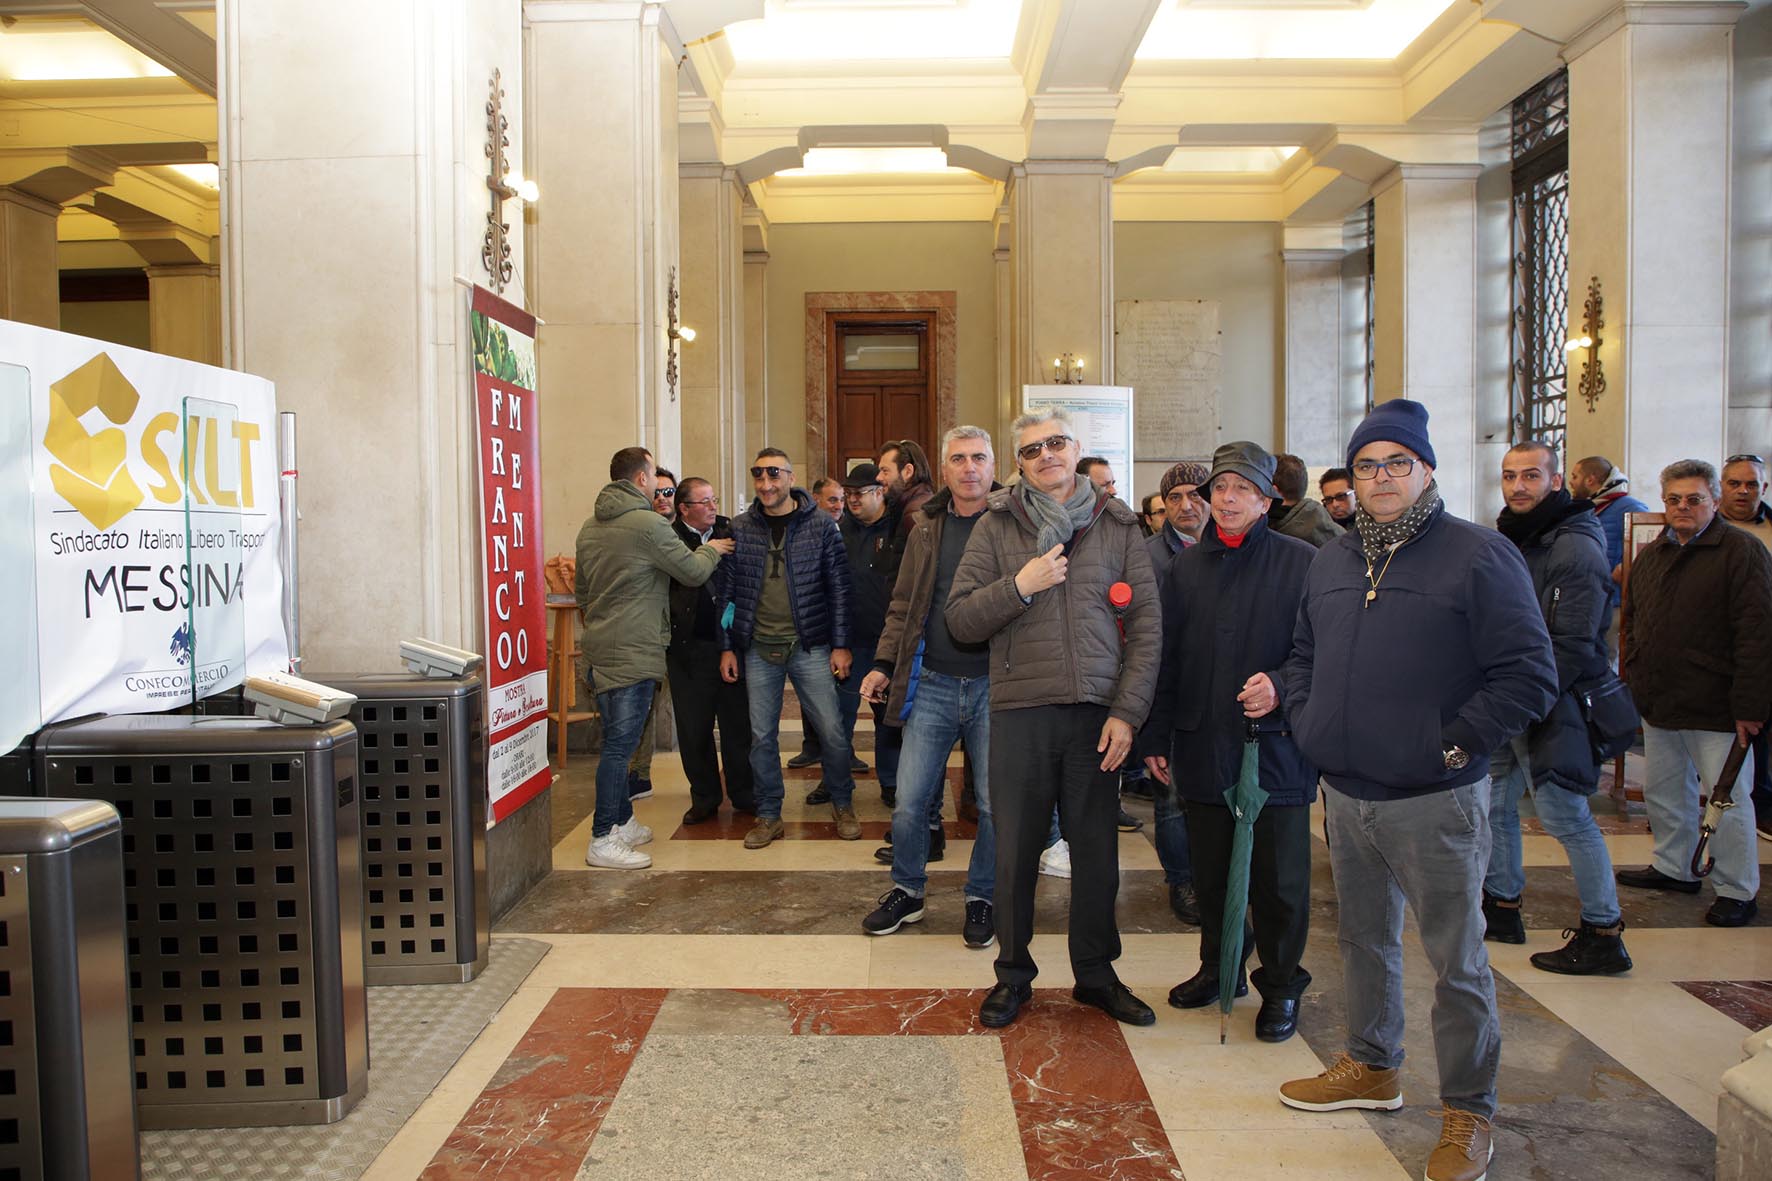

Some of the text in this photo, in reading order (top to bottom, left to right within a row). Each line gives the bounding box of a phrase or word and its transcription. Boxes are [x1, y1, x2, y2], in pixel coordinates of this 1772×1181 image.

[140, 411, 260, 508] SILT
[50, 530, 129, 555] Sindacato
[138, 529, 184, 549] Italiano
[190, 530, 225, 548] Libero
[84, 562, 244, 618] MESSINA
[505, 684, 526, 702] MOSTRA
[492, 748, 500, 760] dal
